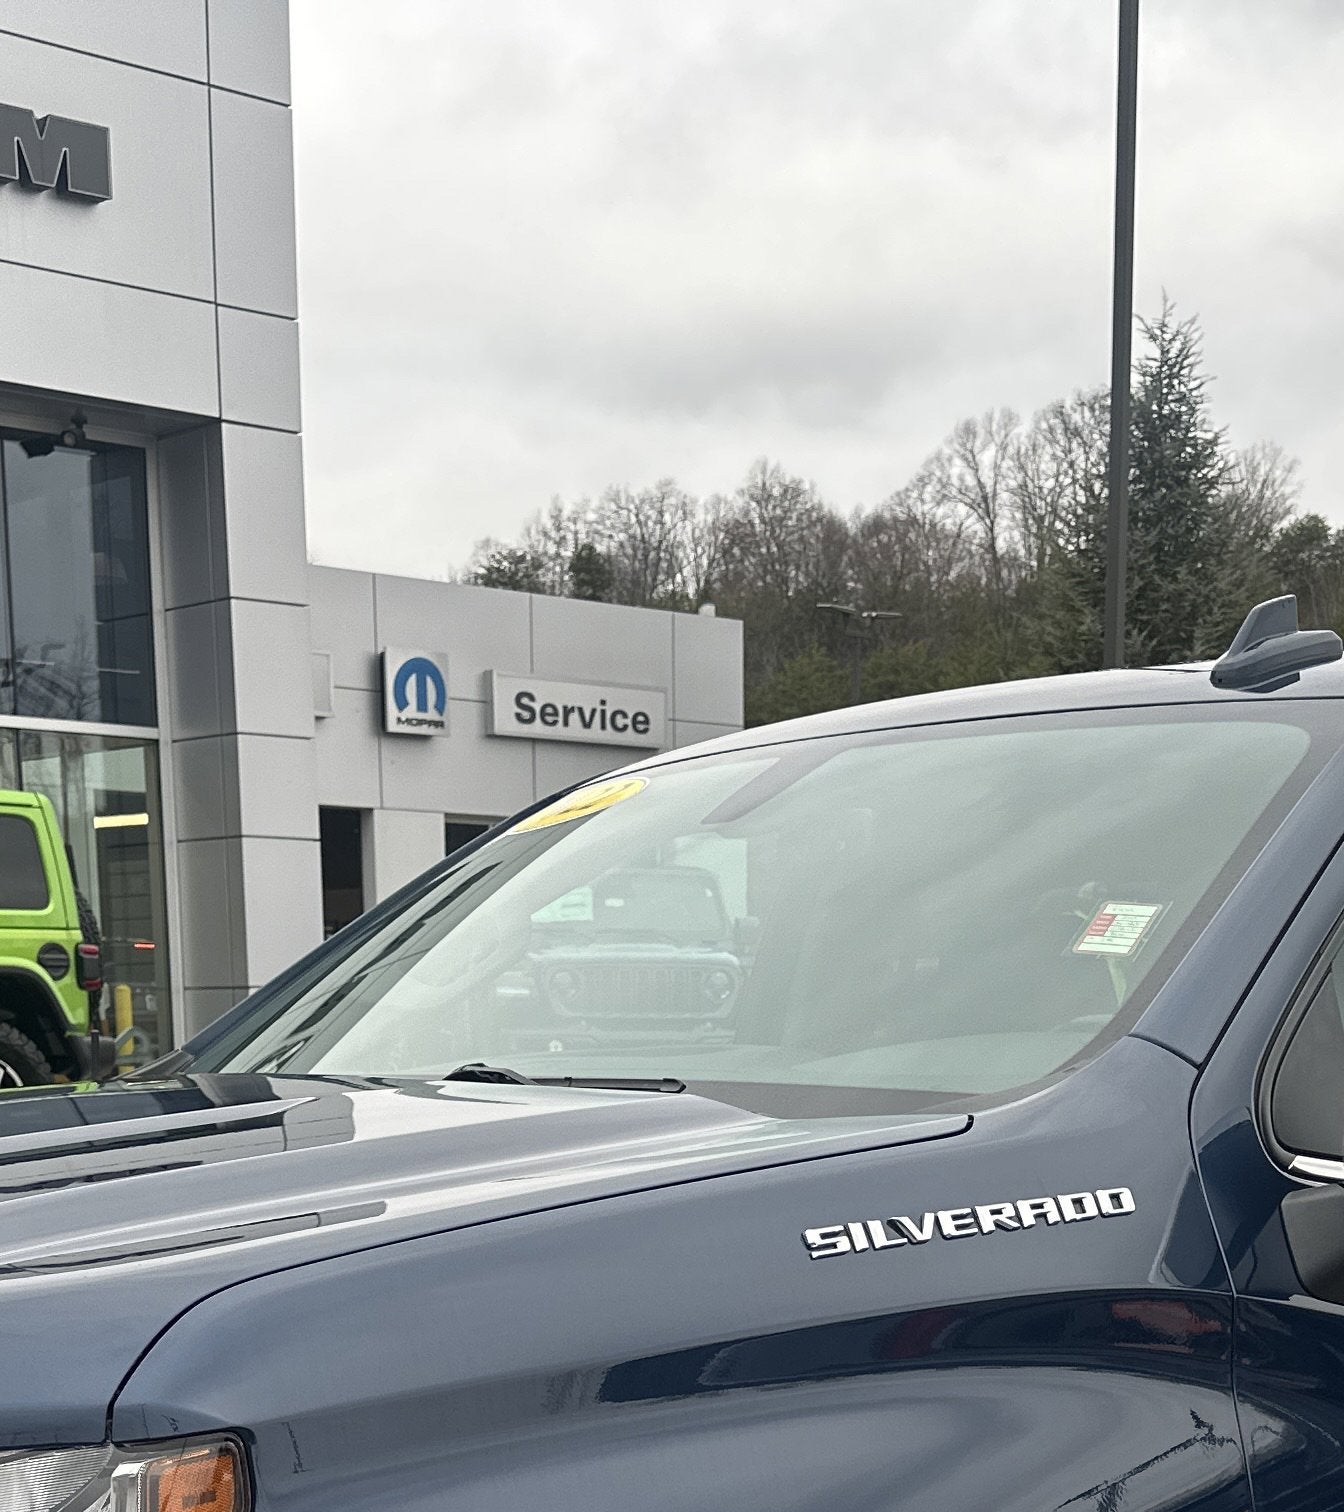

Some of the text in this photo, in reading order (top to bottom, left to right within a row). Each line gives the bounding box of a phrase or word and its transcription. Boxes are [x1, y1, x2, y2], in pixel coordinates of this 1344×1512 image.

[396, 716, 445, 729] MOPAR
[514, 691, 650, 735] Service
[802, 1187, 1136, 1260] SILVERADO
